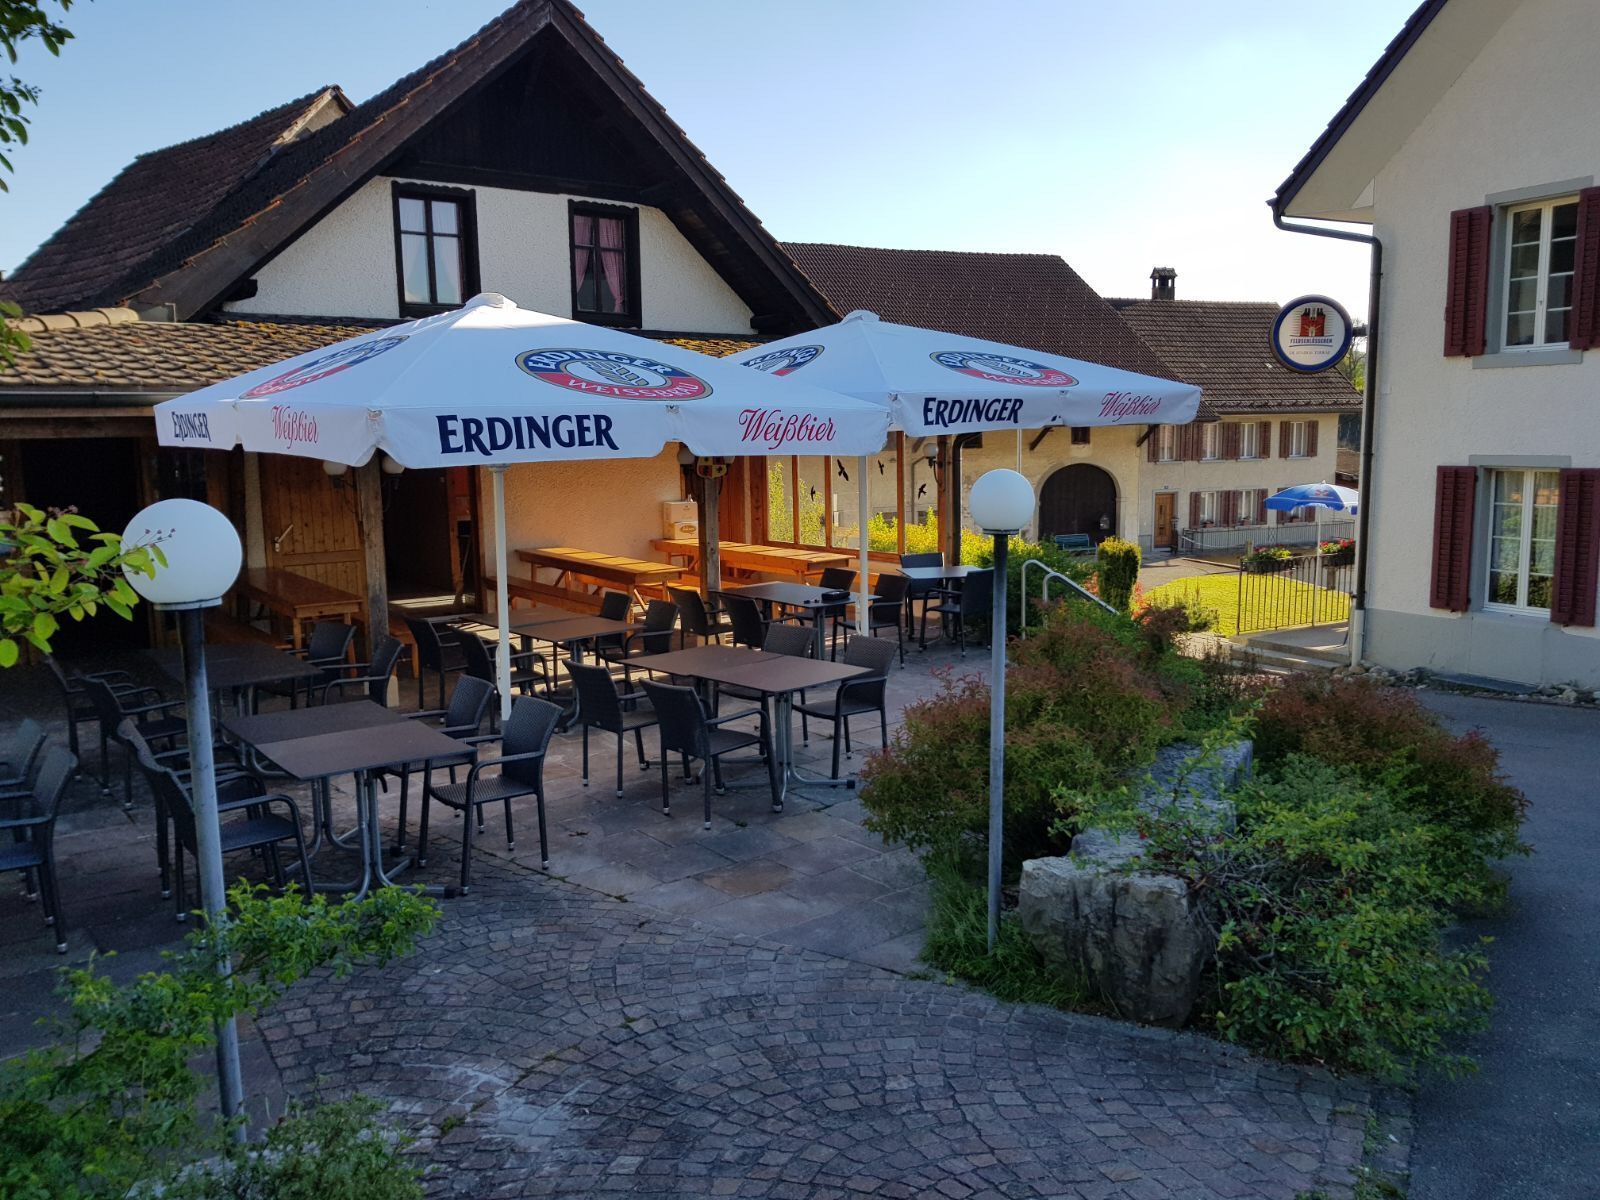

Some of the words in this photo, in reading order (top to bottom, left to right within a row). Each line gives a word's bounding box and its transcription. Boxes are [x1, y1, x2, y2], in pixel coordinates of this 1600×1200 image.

[528, 350, 674, 374] ERDINGER
[922, 397, 1024, 428] ERDINGER
[1097, 391, 1162, 423] Weißbier
[171, 411, 211, 442] ERDINGER
[272, 405, 319, 449] Weißbier
[435, 414, 620, 456] ERDINGER
[738, 408, 836, 450] Weißbier
